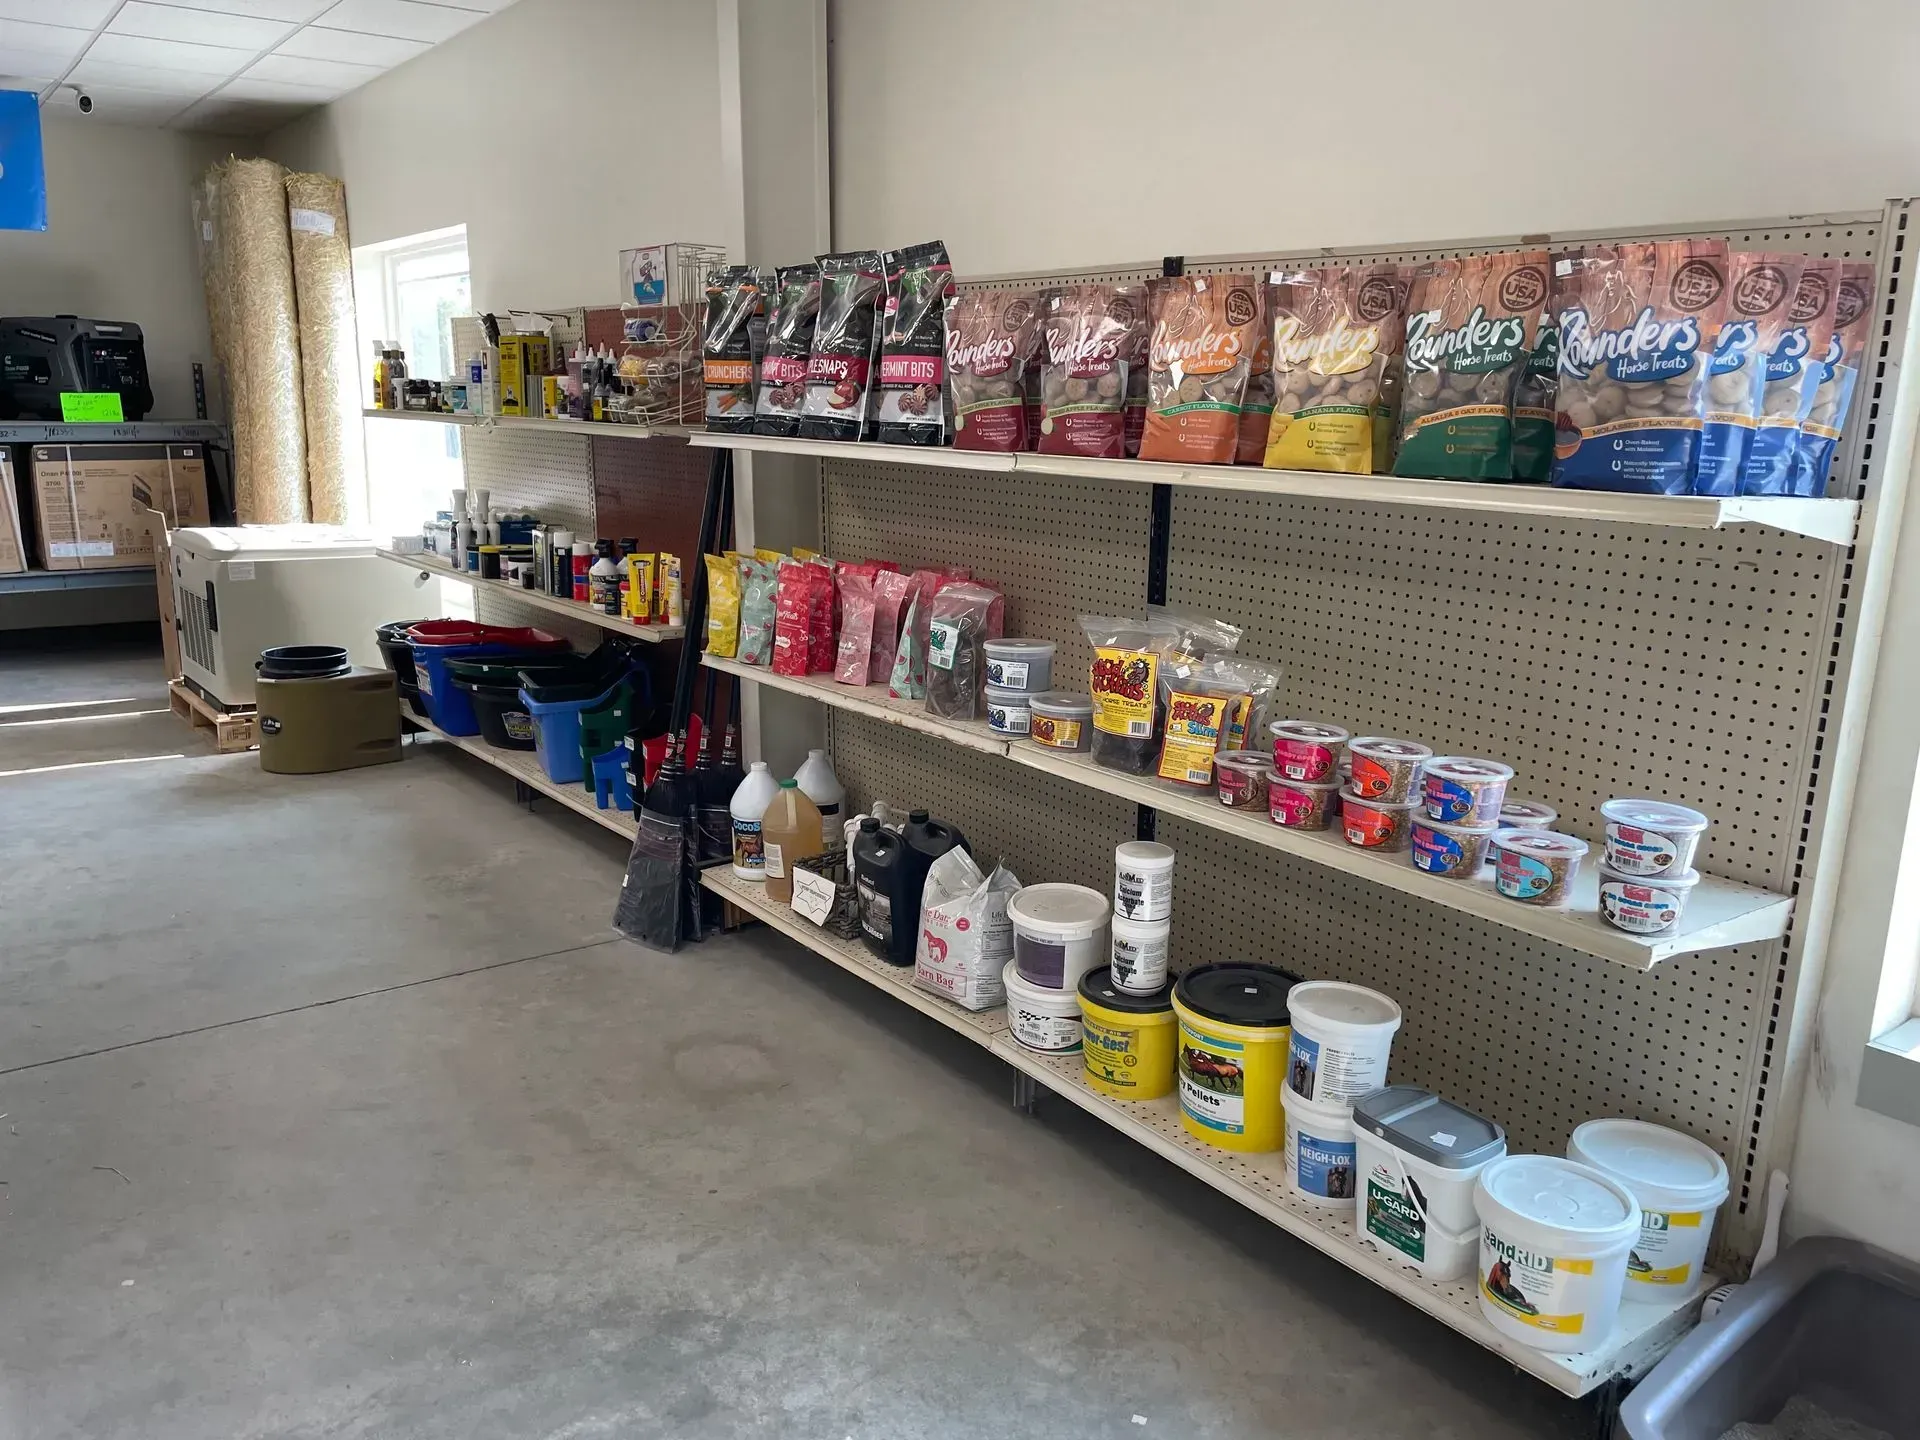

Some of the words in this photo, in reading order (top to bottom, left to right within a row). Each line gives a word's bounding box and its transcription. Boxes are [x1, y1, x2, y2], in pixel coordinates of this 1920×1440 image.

[1506, 283, 1538, 300] USA
[1679, 279, 1712, 298] USA
[1741, 283, 1775, 304] USA
[1228, 303, 1251, 317] USA
[1362, 294, 1388, 311] USA
[1406, 306, 1523, 370] Rounders
[1557, 309, 1698, 376] Rounders
[975, 360, 991, 374] Horse
[991, 356, 1009, 369] Treats
[1069, 362, 1087, 374] Horse
[1087, 358, 1110, 371] Treats
[1207, 353, 1232, 367] Treats
[1455, 354, 1482, 371] Horse
[1483, 350, 1512, 365] Treats
[1616, 358, 1650, 378] Horse
[1650, 353, 1687, 370] Treats
[708, 365, 752, 379] CRUNCHERS
[781, 365, 803, 378] BITS
[911, 361, 934, 377] BITS
[1167, 404, 1192, 414] CARROT
[1302, 407, 1335, 417] BANANA
[1421, 411, 1454, 424] ALFALFA
[1592, 421, 1641, 435] MOLASSES
[1641, 419, 1683, 428] FLAVOR
[1625, 439, 1660, 447] Oven-Baked
[1092, 658, 1125, 676] Stud
[1092, 674, 1144, 702] Muffins
[1122, 700, 1147, 708] TREATS
[1119, 884, 1142, 897] Calcium
[1114, 953, 1135, 966] Calcium
[936, 973, 954, 991] Bag
[1187, 1083, 1220, 1106] Pellets
[1301, 1147, 1351, 1165] NEIGH-LOX
[1372, 1188, 1420, 1222] U-GARD
[1484, 1225, 1549, 1272] SandRID
